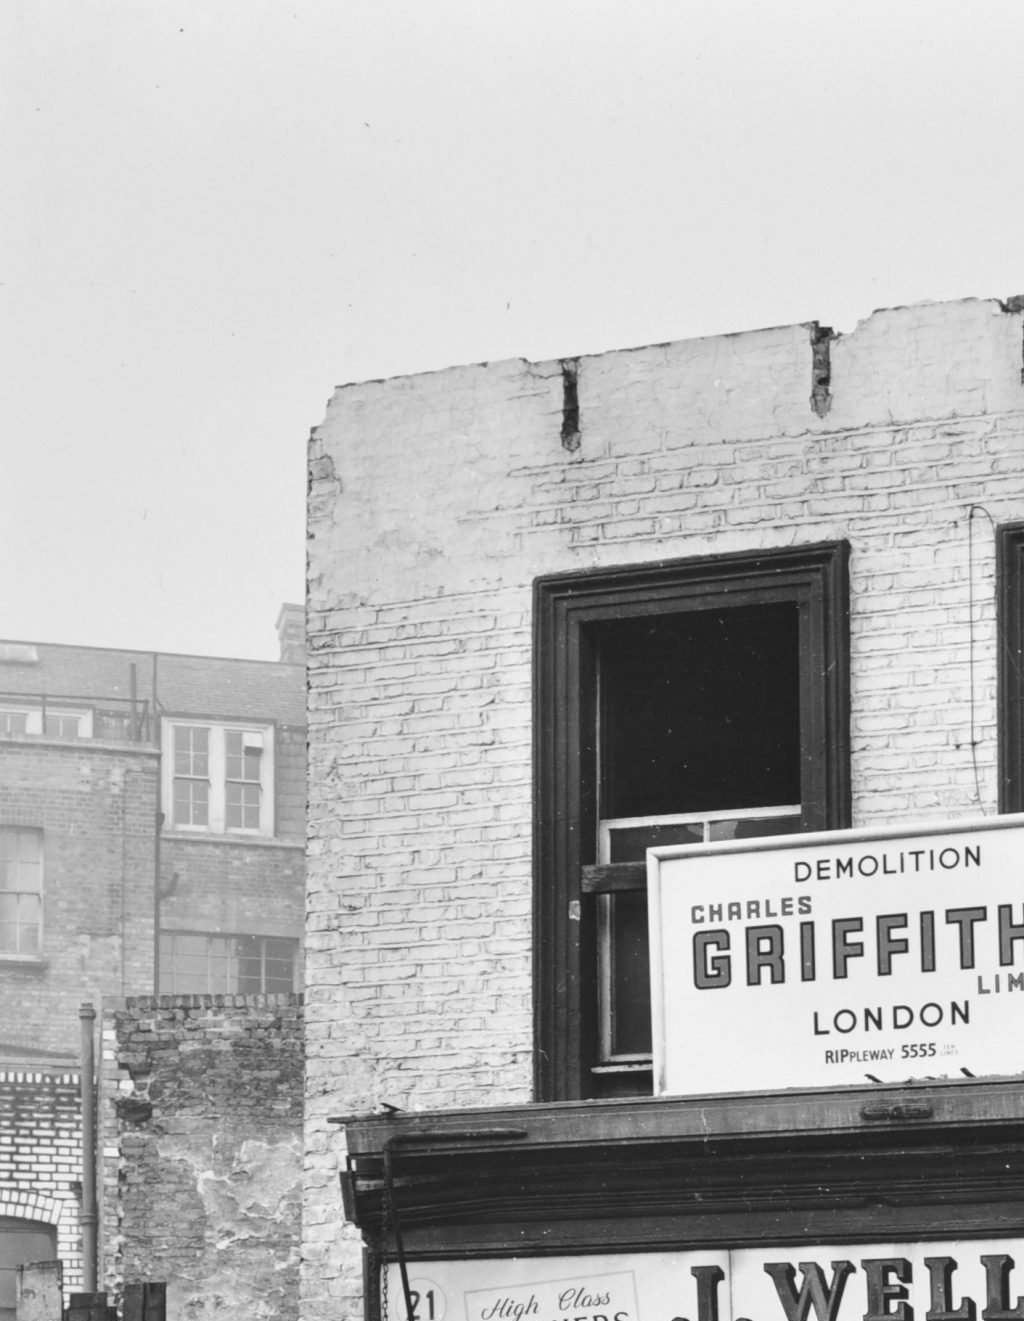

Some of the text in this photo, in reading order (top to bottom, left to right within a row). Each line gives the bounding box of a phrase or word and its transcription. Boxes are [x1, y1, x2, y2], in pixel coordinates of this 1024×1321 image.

[795, 846, 980, 882] DEMOLITION
[691, 896, 811, 923] CHARLES
[814, 1000, 969, 1035] LONDON
[902, 1043, 936, 1058] 5555
[406, 1290, 435, 1321] 21
[559, 1287, 610, 1310] Class
